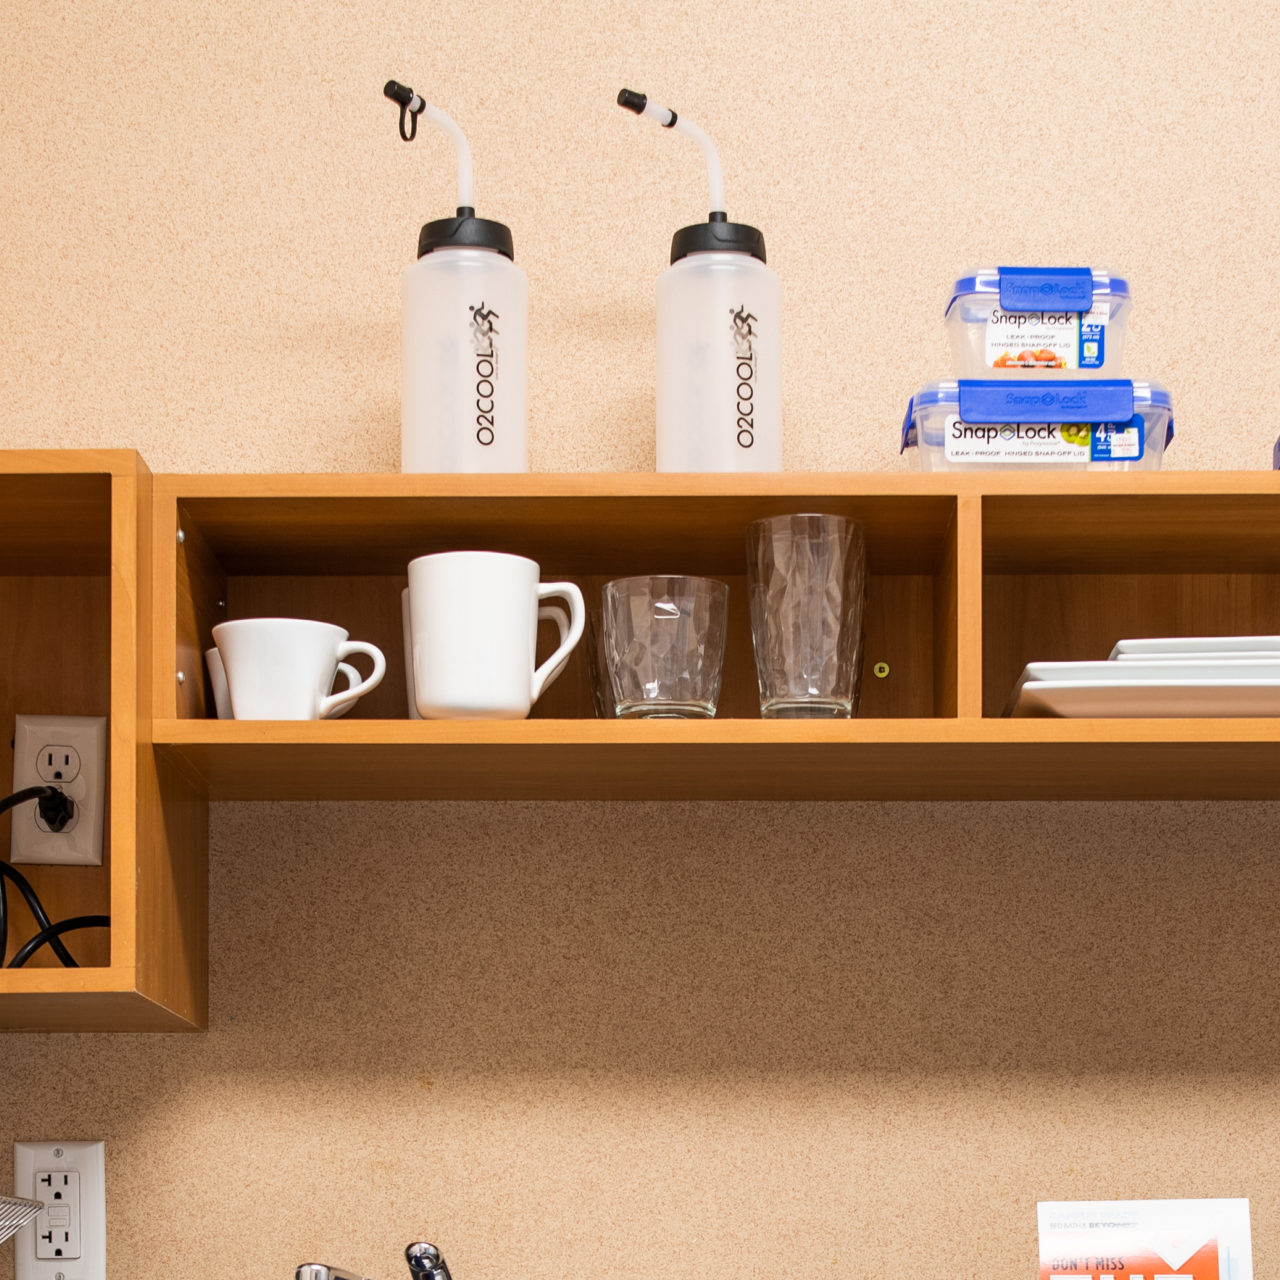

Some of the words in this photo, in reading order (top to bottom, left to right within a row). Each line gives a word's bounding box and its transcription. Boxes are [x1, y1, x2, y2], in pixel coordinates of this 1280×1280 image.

[991, 310, 1027, 328] Snap
[1040, 311, 1072, 325] Lock
[476, 350, 495, 446] O2COOL
[736, 353, 754, 448] O2COOL
[952, 421, 998, 445] Snap
[1016, 422, 1056, 439] Lock
[1096, 423, 1106, 442] 4
[1052, 1257, 1089, 1270] DON'T
[1095, 1257, 1125, 1270] MISS
